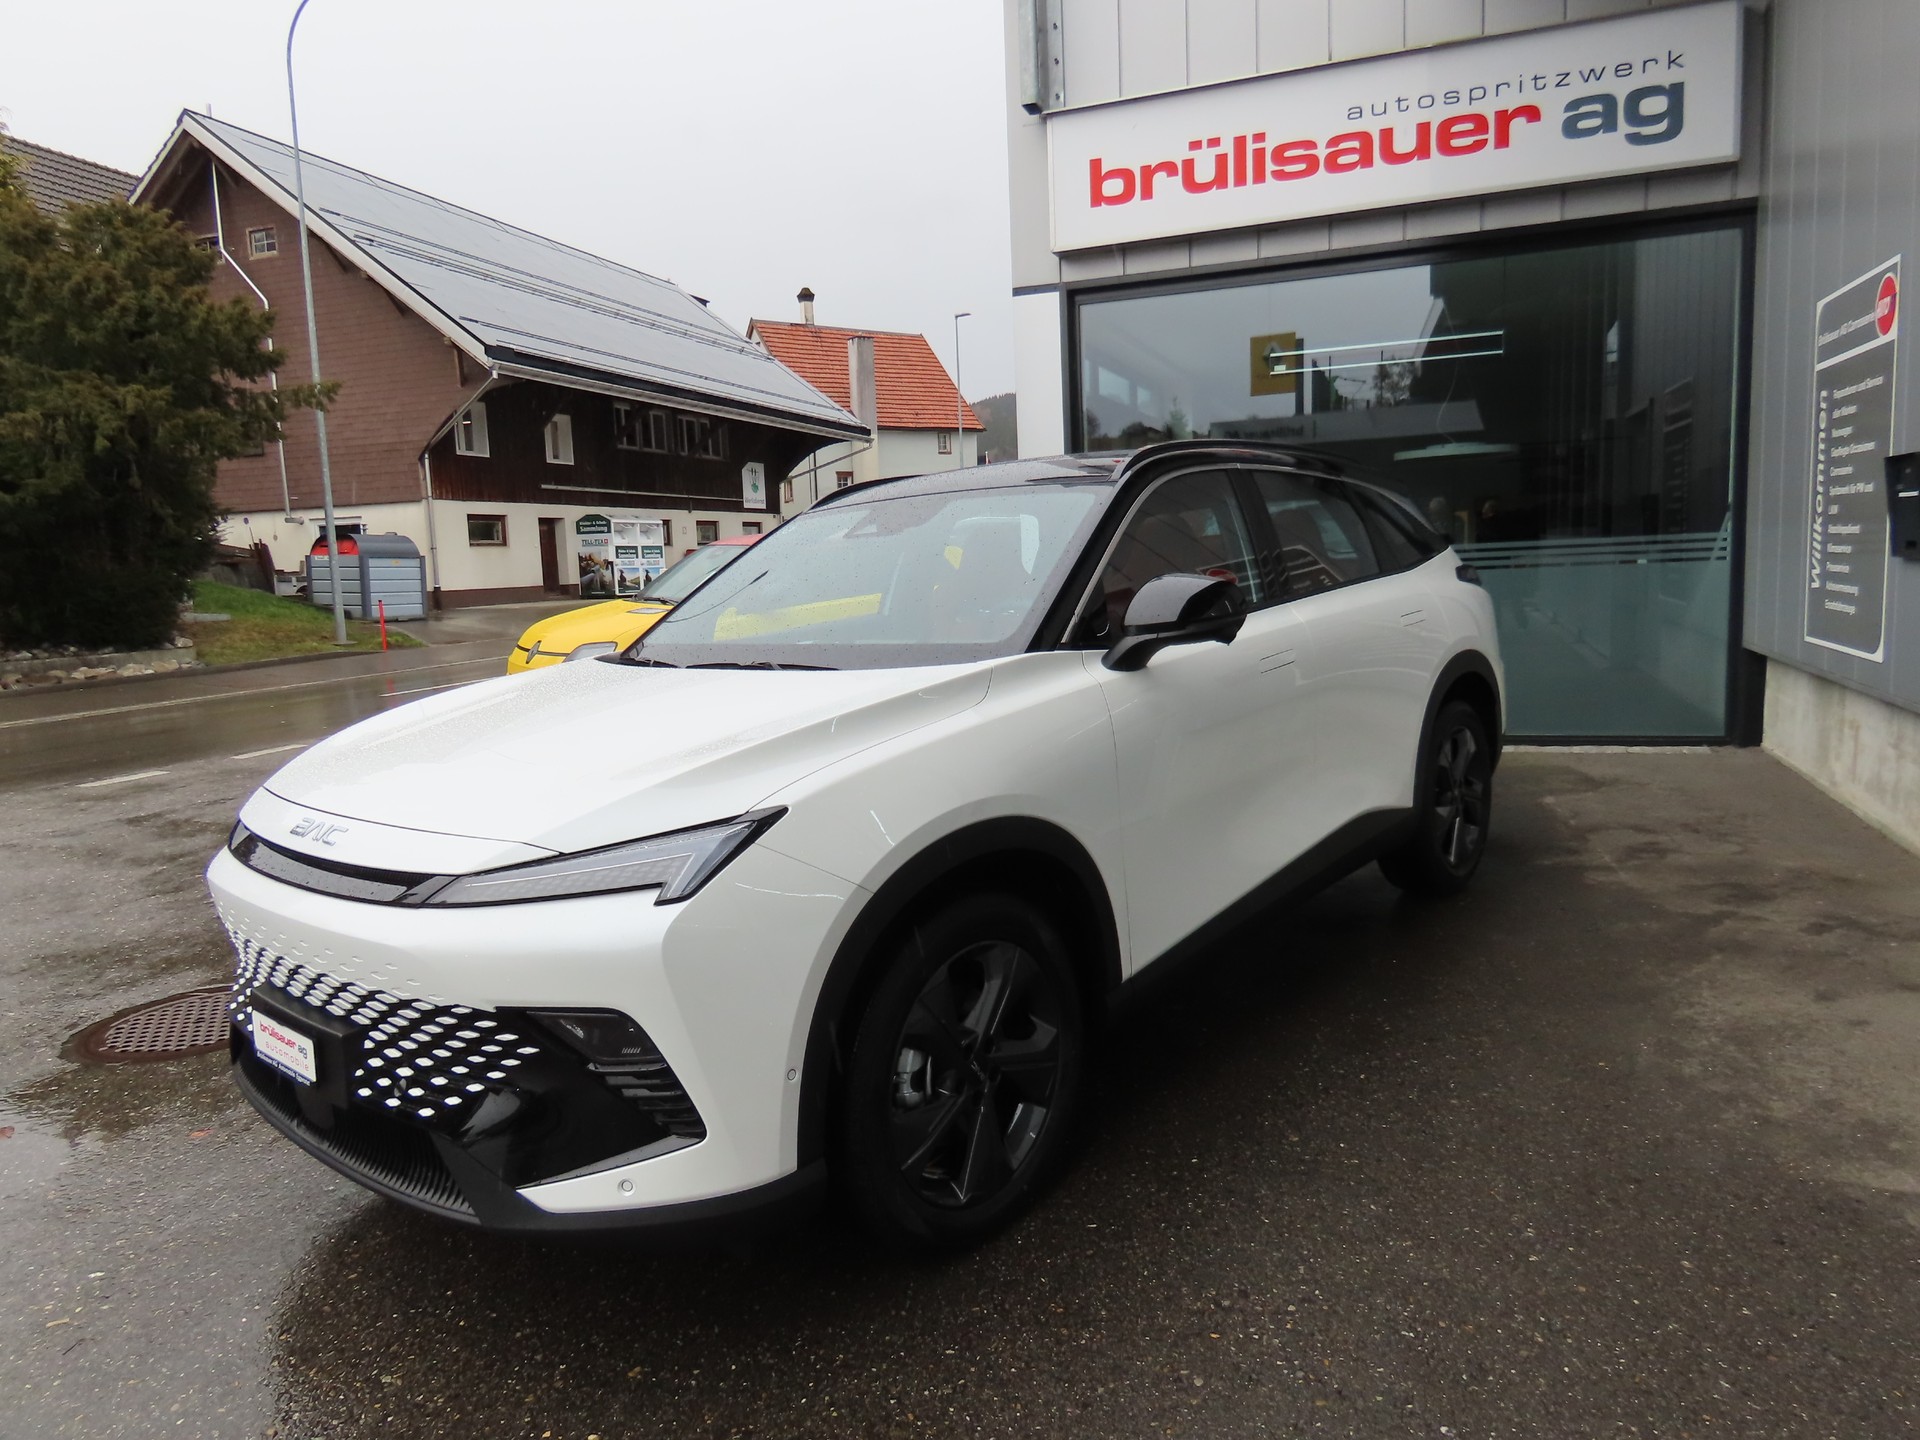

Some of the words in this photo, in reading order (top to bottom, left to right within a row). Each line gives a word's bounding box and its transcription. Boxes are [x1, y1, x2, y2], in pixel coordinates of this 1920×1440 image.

[1347, 49, 1686, 120] autospritzwerk
[1089, 104, 1543, 208] brülisauer
[1561, 80, 1686, 147] ag
[1811, 389, 1828, 589] Willkommen
[265, 1041, 310, 1071] automobile
[297, 1044, 308, 1059] ag
